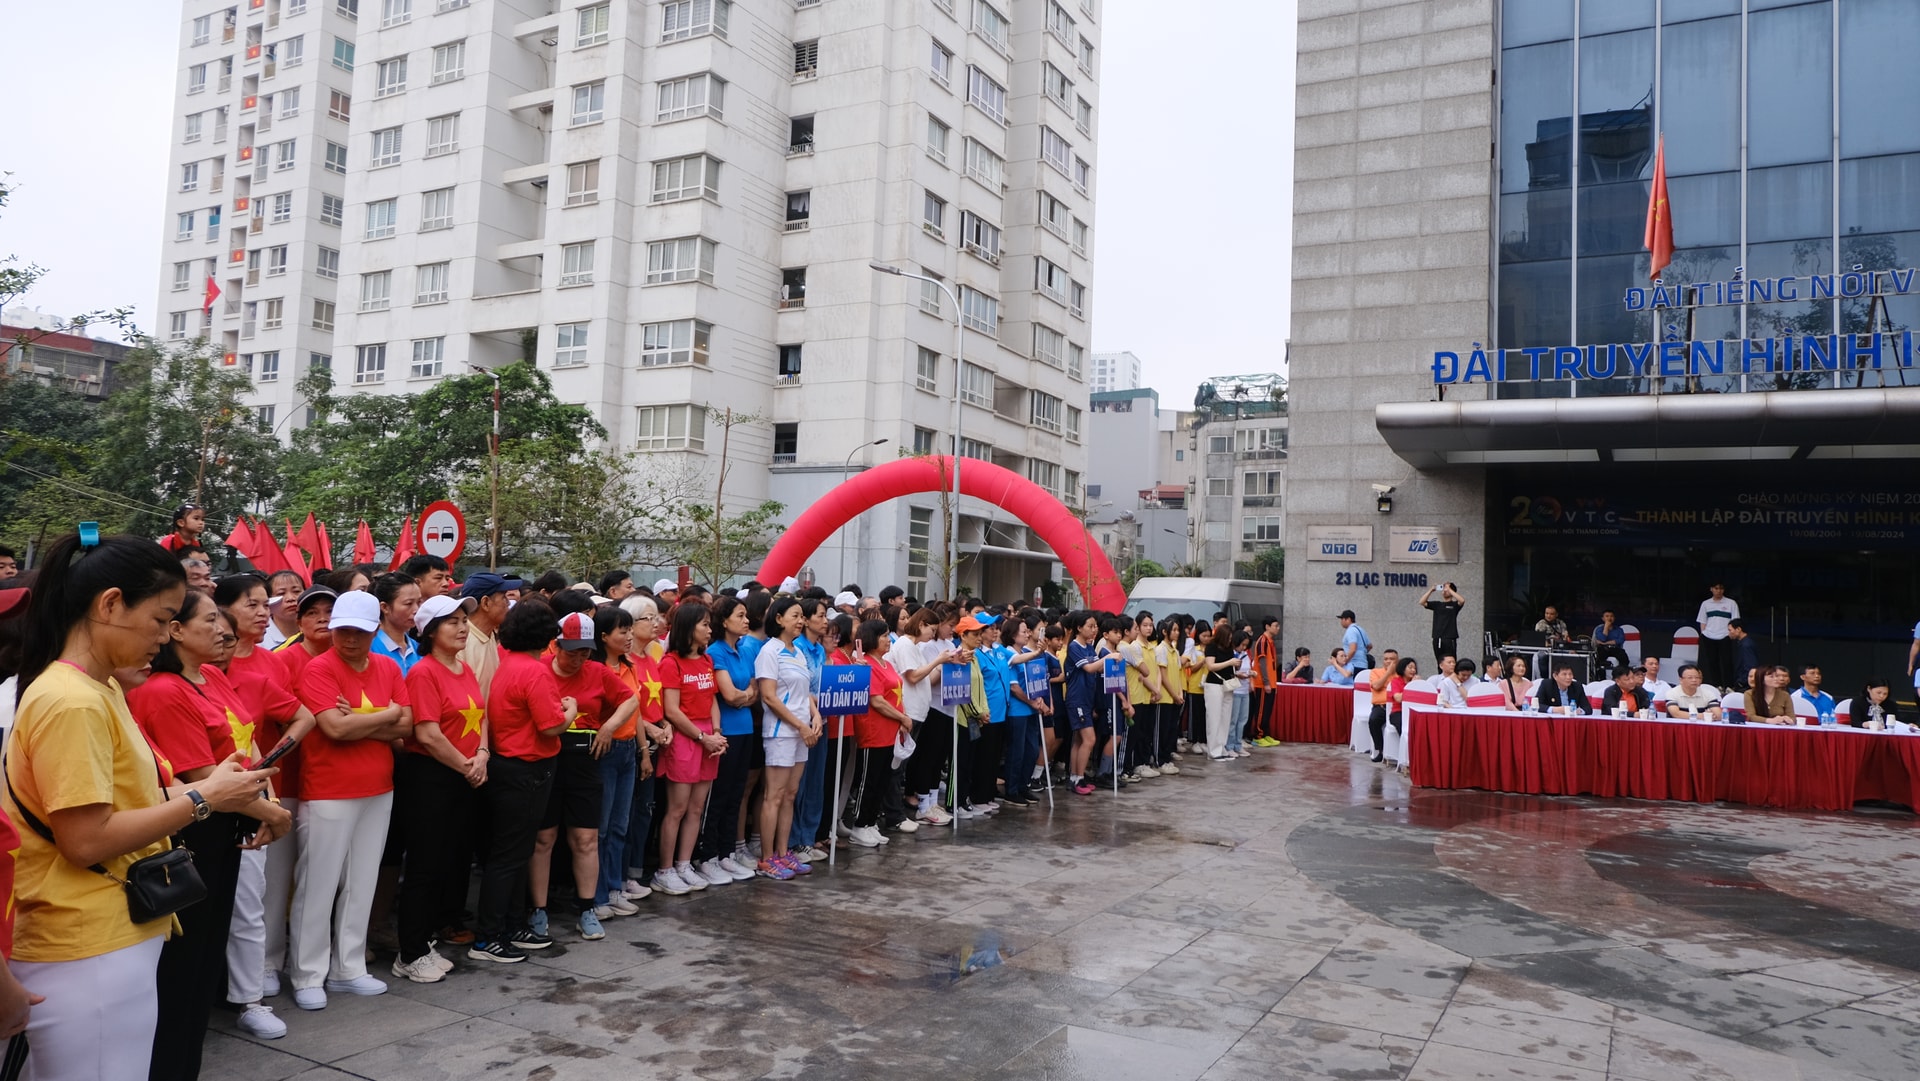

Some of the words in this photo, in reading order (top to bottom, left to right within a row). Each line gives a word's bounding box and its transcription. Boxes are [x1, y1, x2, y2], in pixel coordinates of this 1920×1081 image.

[1624, 279, 1683, 311] ĐÀI
[1686, 266, 1798, 304] TIẾNG
[1810, 264, 1876, 299] NÓI
[1889, 268, 1916, 295] V
[1431, 342, 1507, 384] ĐÀI
[1522, 324, 1725, 382] TRUYỀN
[1742, 327, 1883, 373] HÌNH
[1636, 508, 1697, 524] THÀNH
[1700, 507, 1735, 527] LẬP
[1738, 508, 1772, 524] ĐÀI
[1774, 506, 1849, 524] TRUYỀN
[1854, 508, 1904, 525] HÌNH
[1323, 545, 1356, 553] VTC
[1336, 572, 1352, 586] 23
[1355, 573, 1380, 588] LẠC
[1383, 573, 1428, 587] TRUNG
[837, 670, 855, 683] KHỐI
[820, 686, 833, 709] TỔ
[832, 688, 851, 708] DÂN
[852, 685, 870, 707] PHỐ
